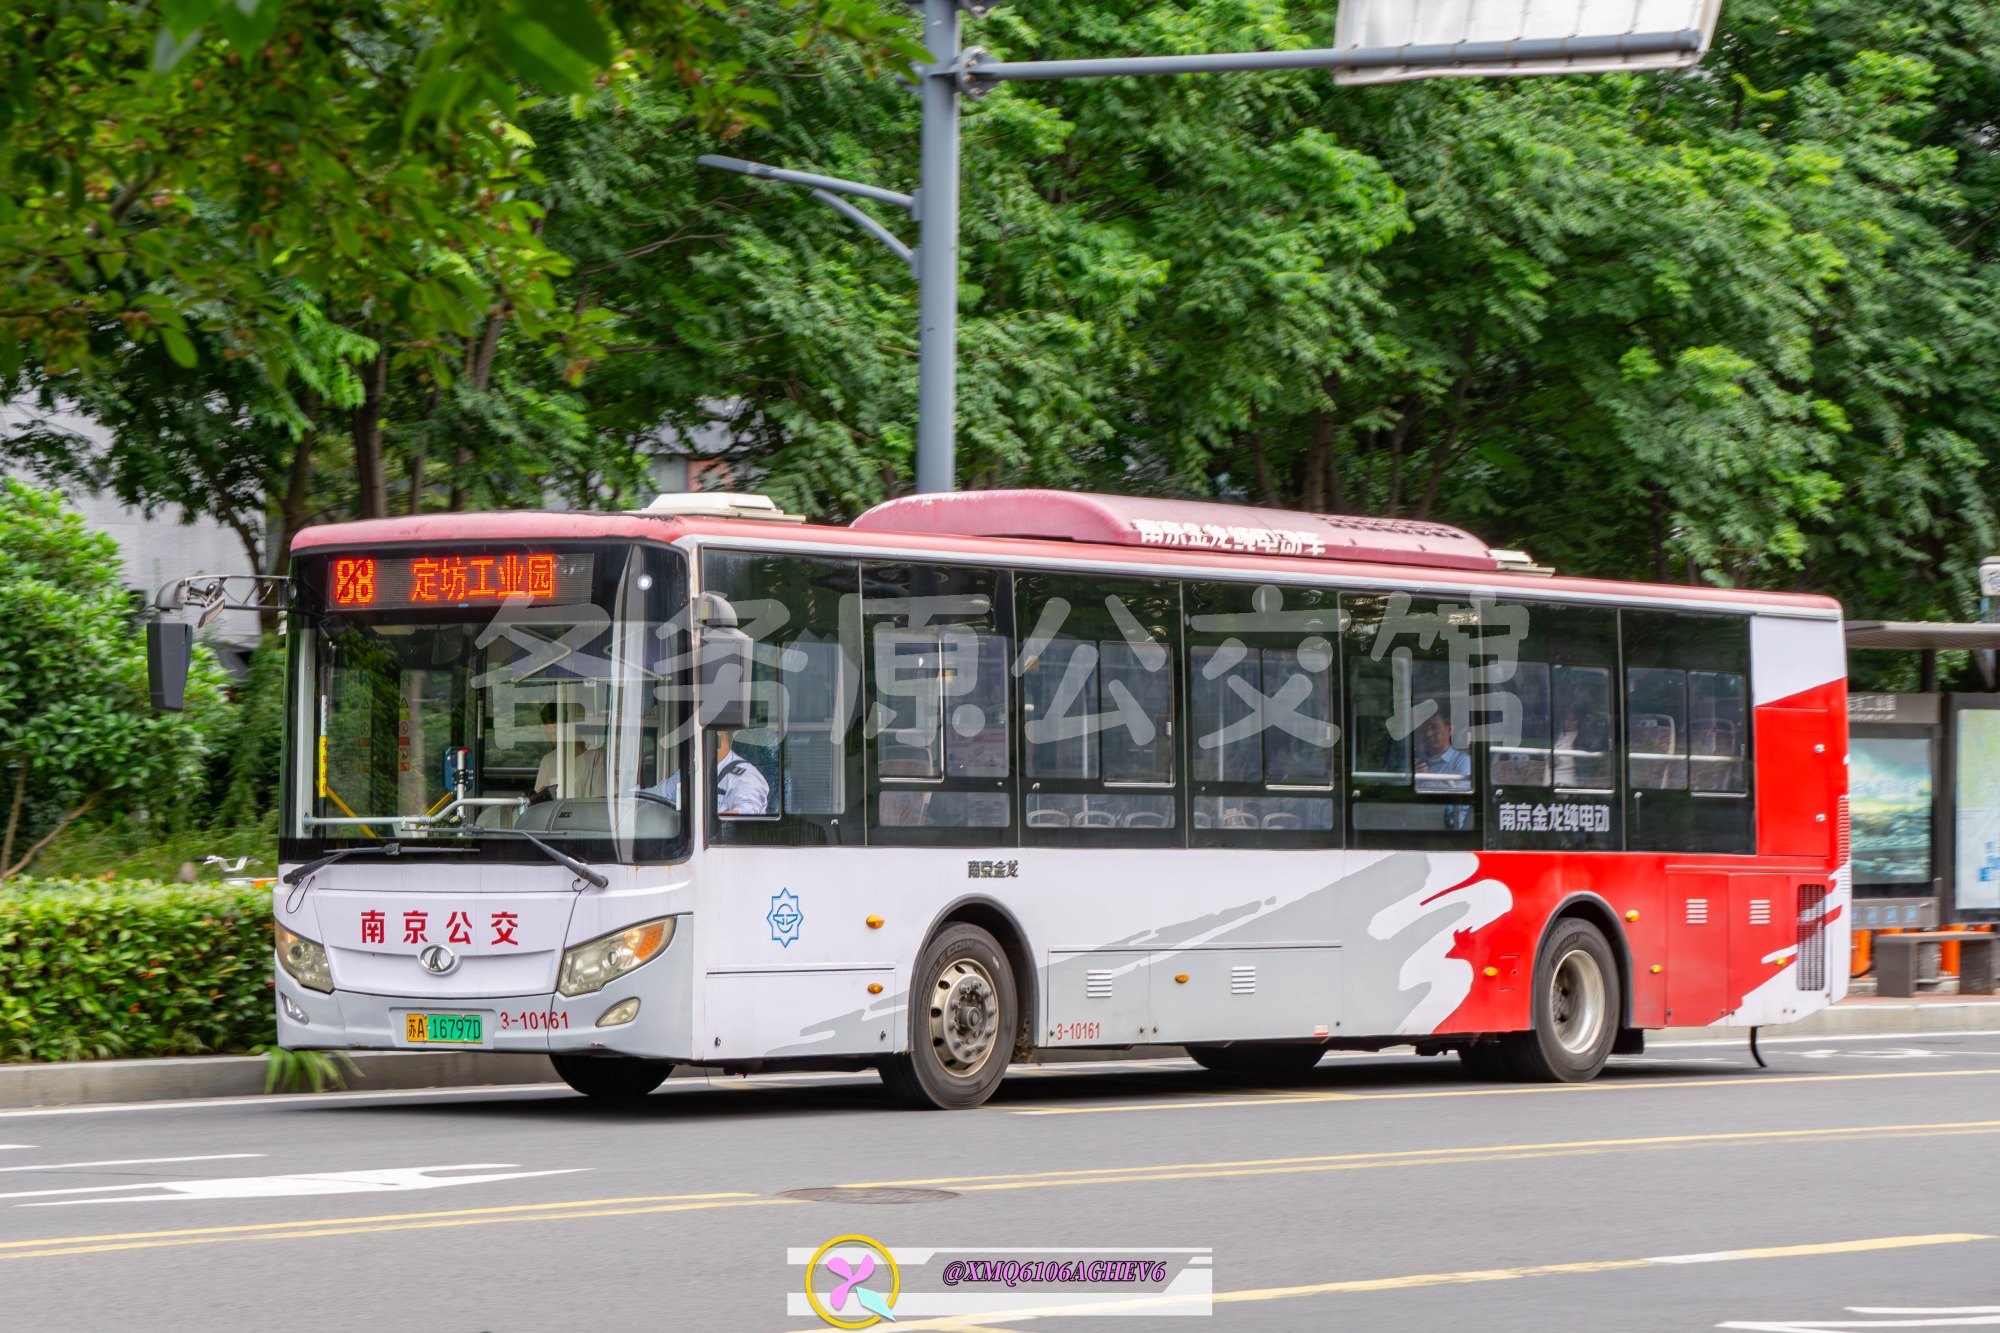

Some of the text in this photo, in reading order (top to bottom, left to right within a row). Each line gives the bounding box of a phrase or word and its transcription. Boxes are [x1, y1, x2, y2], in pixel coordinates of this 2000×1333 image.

[411, 552, 555, 602] 定坊工业园
[1498, 802, 1610, 832] 南京金龙纯电动
[967, 859, 1019, 879] 南京金龙
[360, 909, 519, 946] 南京公交
[499, 1011, 569, 1030] 3-10161
[1056, 1022, 1101, 1040] 3-10161
